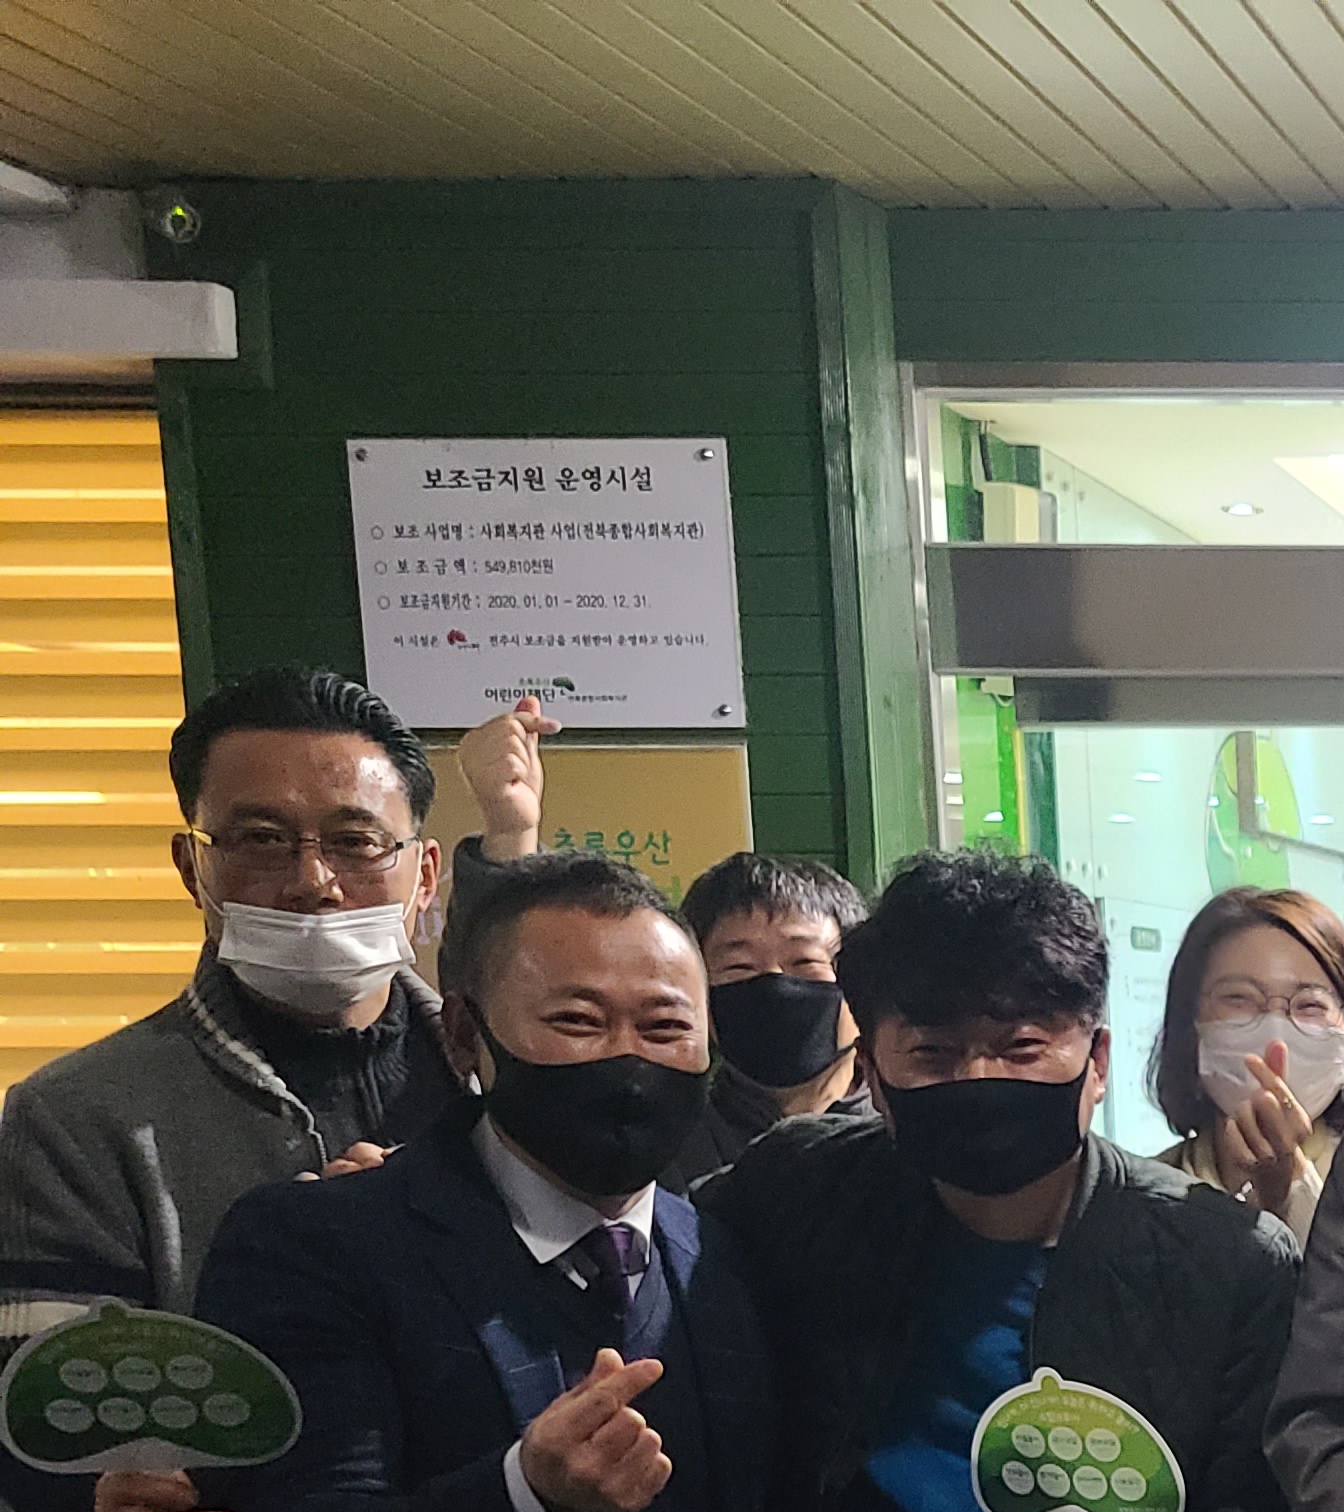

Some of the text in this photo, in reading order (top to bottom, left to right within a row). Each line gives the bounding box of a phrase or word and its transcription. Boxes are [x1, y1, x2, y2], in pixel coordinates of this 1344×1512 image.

[422, 466, 653, 492] 보조금지원 운영시설
[393, 524, 419, 538] 보조
[425, 523, 462, 540] 사업명
[481, 523, 545, 540] 사회복지관
